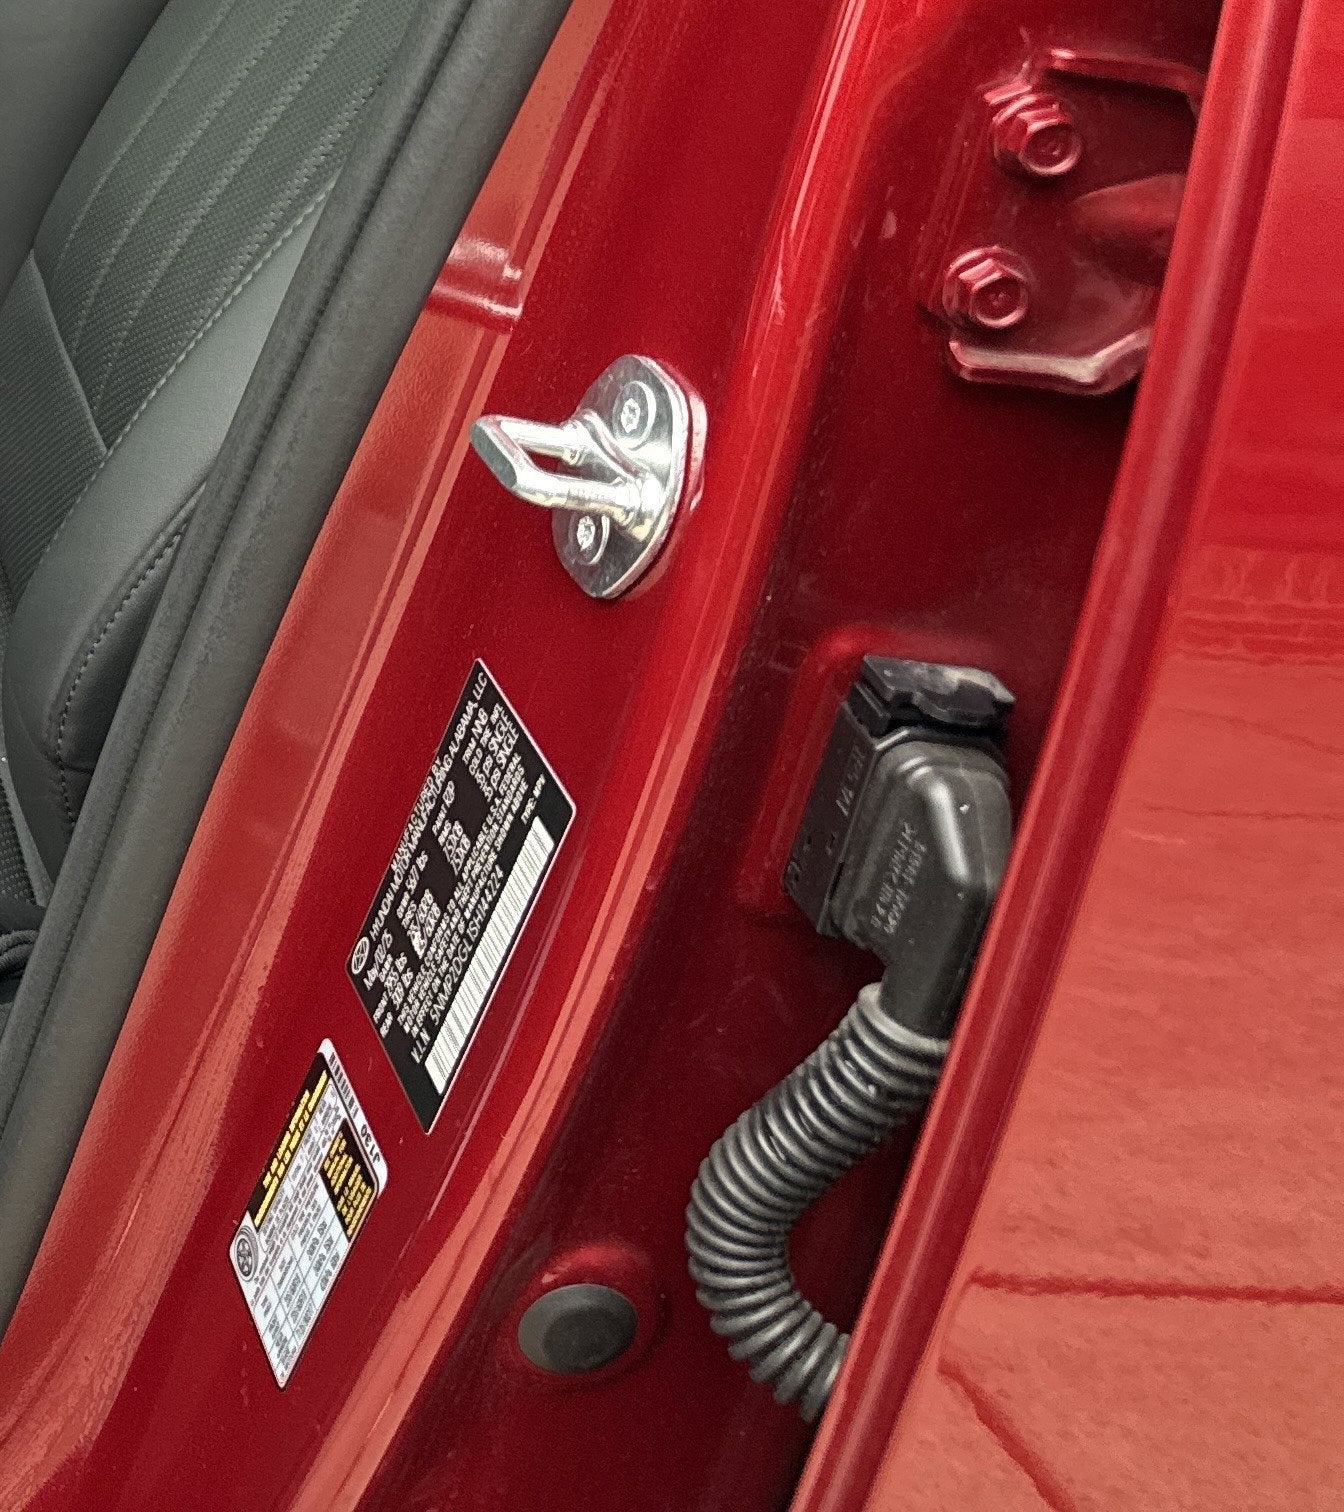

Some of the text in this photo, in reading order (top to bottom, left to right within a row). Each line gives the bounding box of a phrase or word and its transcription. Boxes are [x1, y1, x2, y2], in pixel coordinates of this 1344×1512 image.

[468, 747, 482, 775] COLD
[471, 707, 488, 739] NNB
[487, 709, 511, 756] SINGLE
[495, 722, 519, 769] SINGLE
[369, 888, 394, 941] HYUNDAI
[389, 845, 411, 892] MOTOR
[406, 753, 452, 852] MANUFACTURING
[472, 671, 487, 700] LLC
[390, 756, 441, 872] MANUFACTURED BY
[396, 1002, 409, 1025] THIS
[406, 963, 426, 1004] VEHICLE
[423, 912, 449, 967] CONFORMS
[446, 898, 455, 913] TO
[453, 881, 463, 900] ALL
[461, 822, 489, 882] APPLICABLE
[498, 752, 521, 795] FEDERAL
[402, 763, 524, 1033] MOTOR VEHICLE SAFETY AND THEFT PREVENTION STANDARDS
[410, 777, 528, 1038] IN EFFECT ON THE DATE OF MANUFACTURE SHOWN ABOVE
